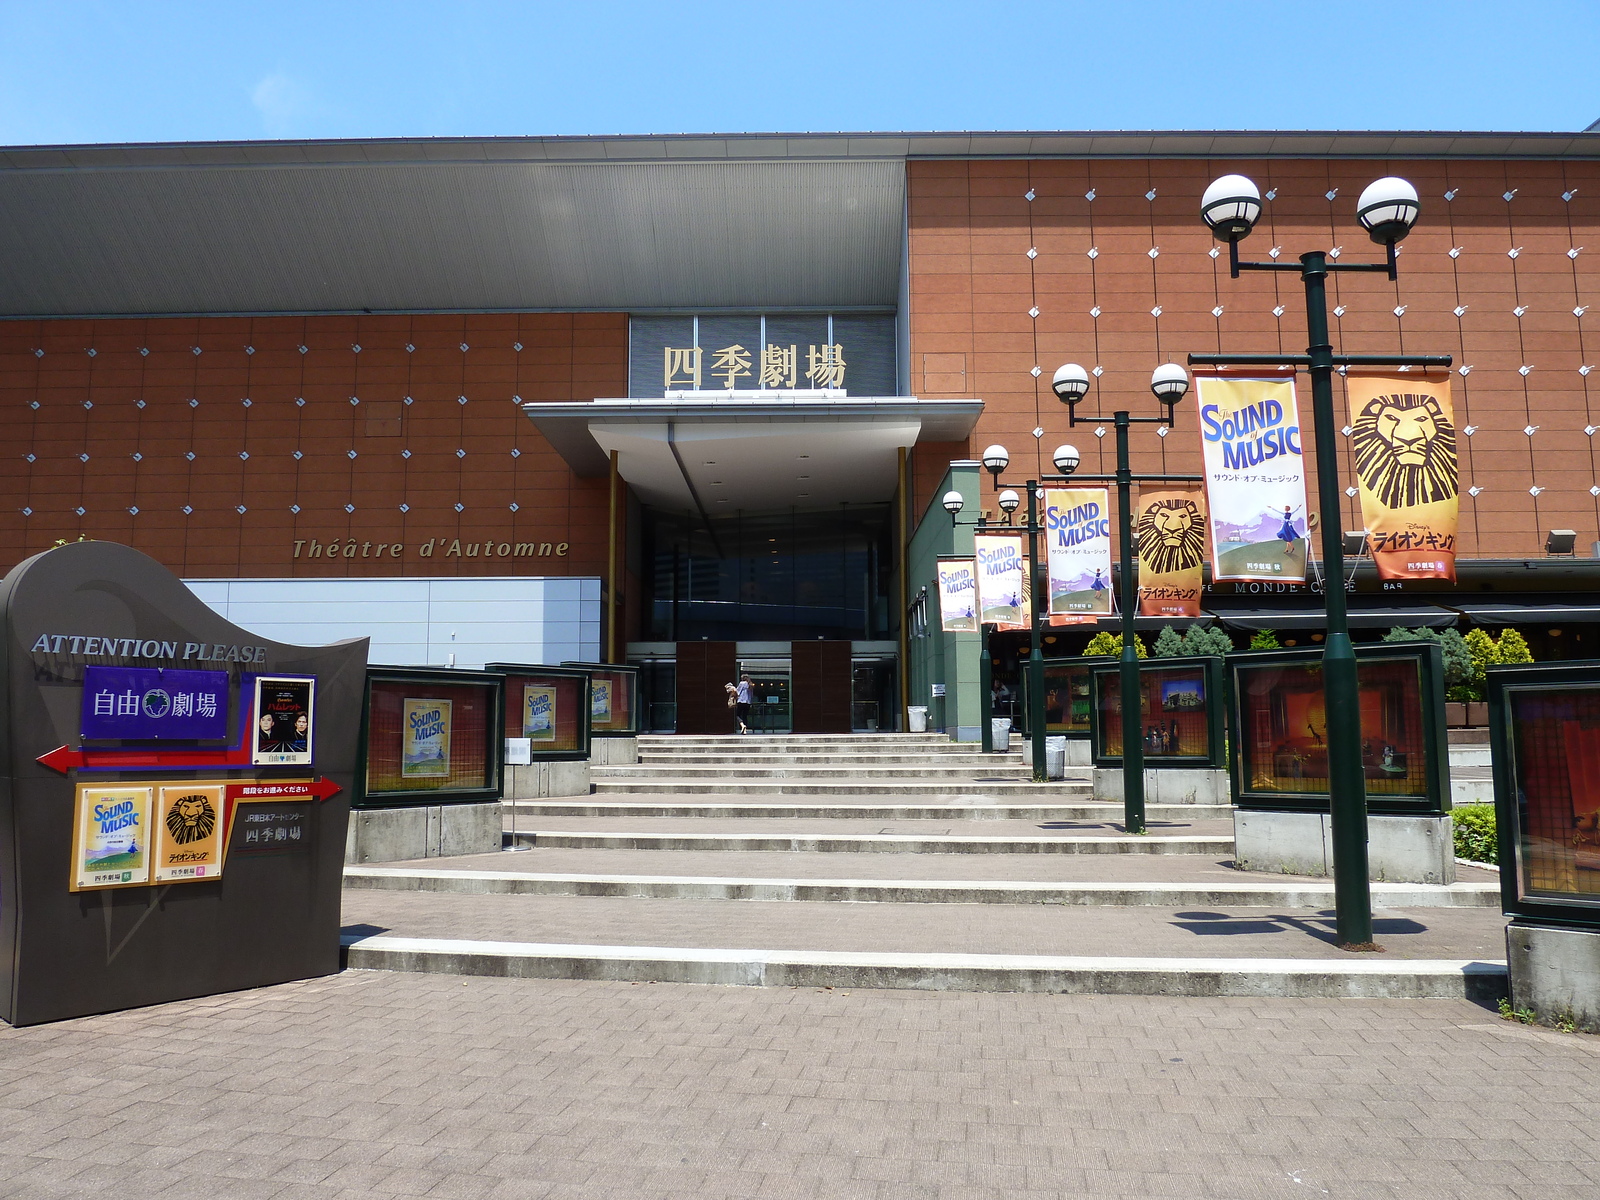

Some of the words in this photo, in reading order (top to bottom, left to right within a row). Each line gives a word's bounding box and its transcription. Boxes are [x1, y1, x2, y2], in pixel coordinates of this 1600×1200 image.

[664, 344, 847, 388] 四季劇場
[1201, 400, 1283, 442] SOUND
[1222, 426, 1302, 470] MUSIC
[1047, 502, 1099, 530] SOUND
[1058, 519, 1110, 547] MUSIC
[1373, 531, 1455, 552] ライオンキング
[293, 538, 404, 558] Théâtre
[419, 538, 569, 558] d'Automne
[978, 546, 1016, 564] SOUND
[940, 569, 970, 585] SOUND
[986, 557, 1022, 576] MUSIC
[946, 578, 975, 594] MUSIC
[1143, 588, 1197, 600] ライオンキング
[31, 633, 178, 659] ATTENTION
[183, 642, 268, 663] PLEASE
[94, 689, 140, 717] 自由
[171, 691, 217, 718] 劇場
[410, 710, 441, 729] SOUND
[415, 721, 446, 741] MUSIC
[94, 801, 134, 822] SOUND
[100, 812, 140, 834] MUSIC
[246, 826, 301, 843] 四季劇場
